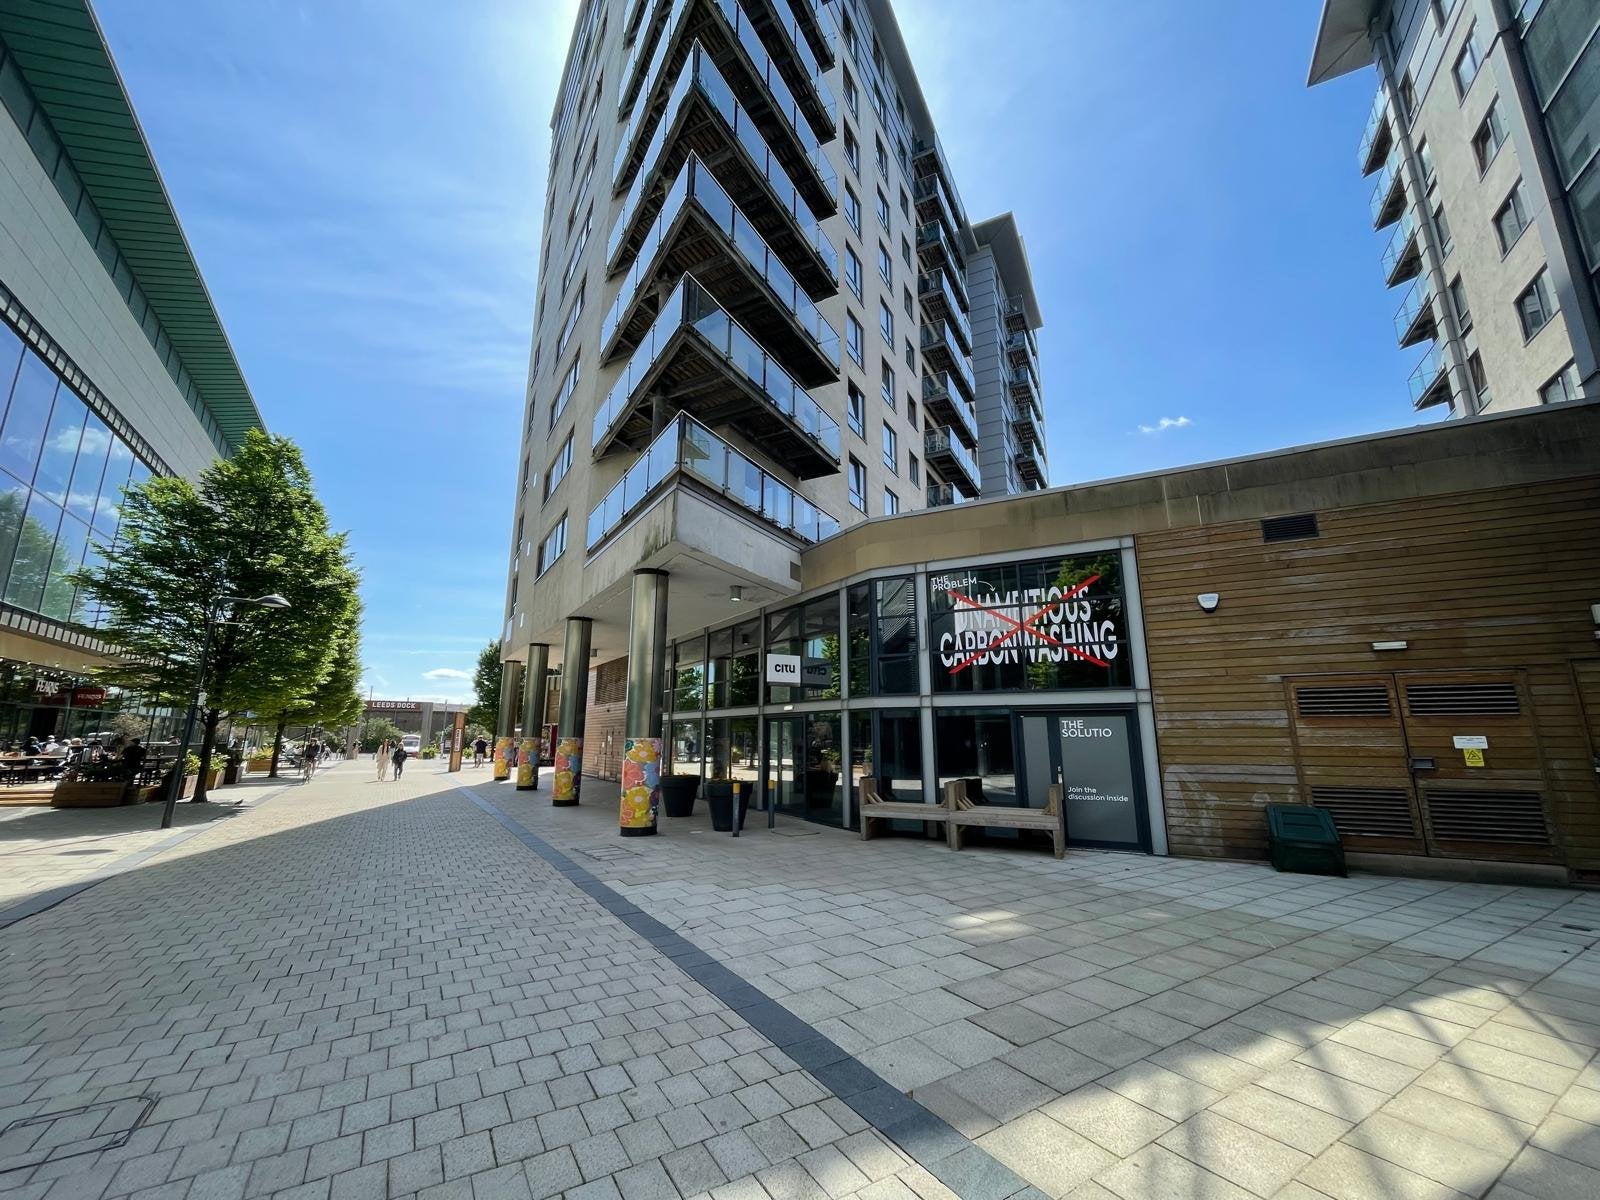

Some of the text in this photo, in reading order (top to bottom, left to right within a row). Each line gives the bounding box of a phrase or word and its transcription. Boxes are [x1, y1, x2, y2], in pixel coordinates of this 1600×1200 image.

[931, 575, 950, 585] THE
[932, 576, 977, 591] PROBLEM
[1061, 720, 1084, 729] THE
[1061, 729, 1112, 737] SOLUTIO
